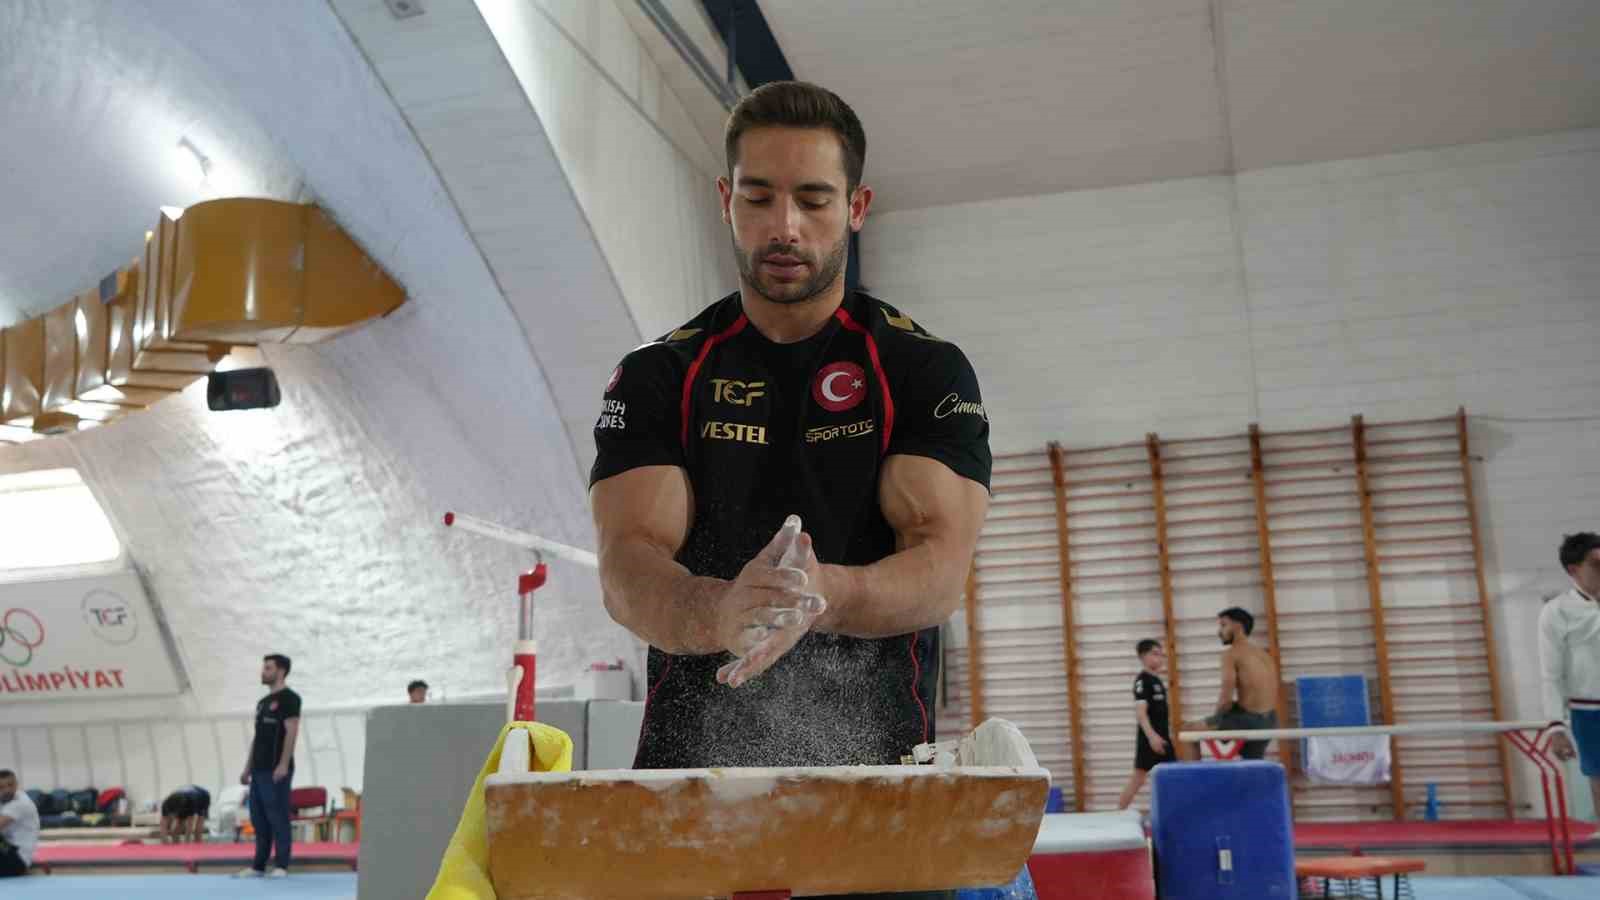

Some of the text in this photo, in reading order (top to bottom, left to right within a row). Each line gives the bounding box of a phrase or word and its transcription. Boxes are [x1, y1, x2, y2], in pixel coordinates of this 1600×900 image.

[711, 378, 766, 407] TCF
[701, 421, 769, 445] VESTEL
[90, 608, 127, 626] TCF
[0, 665, 124, 693] LİMPİYAT
